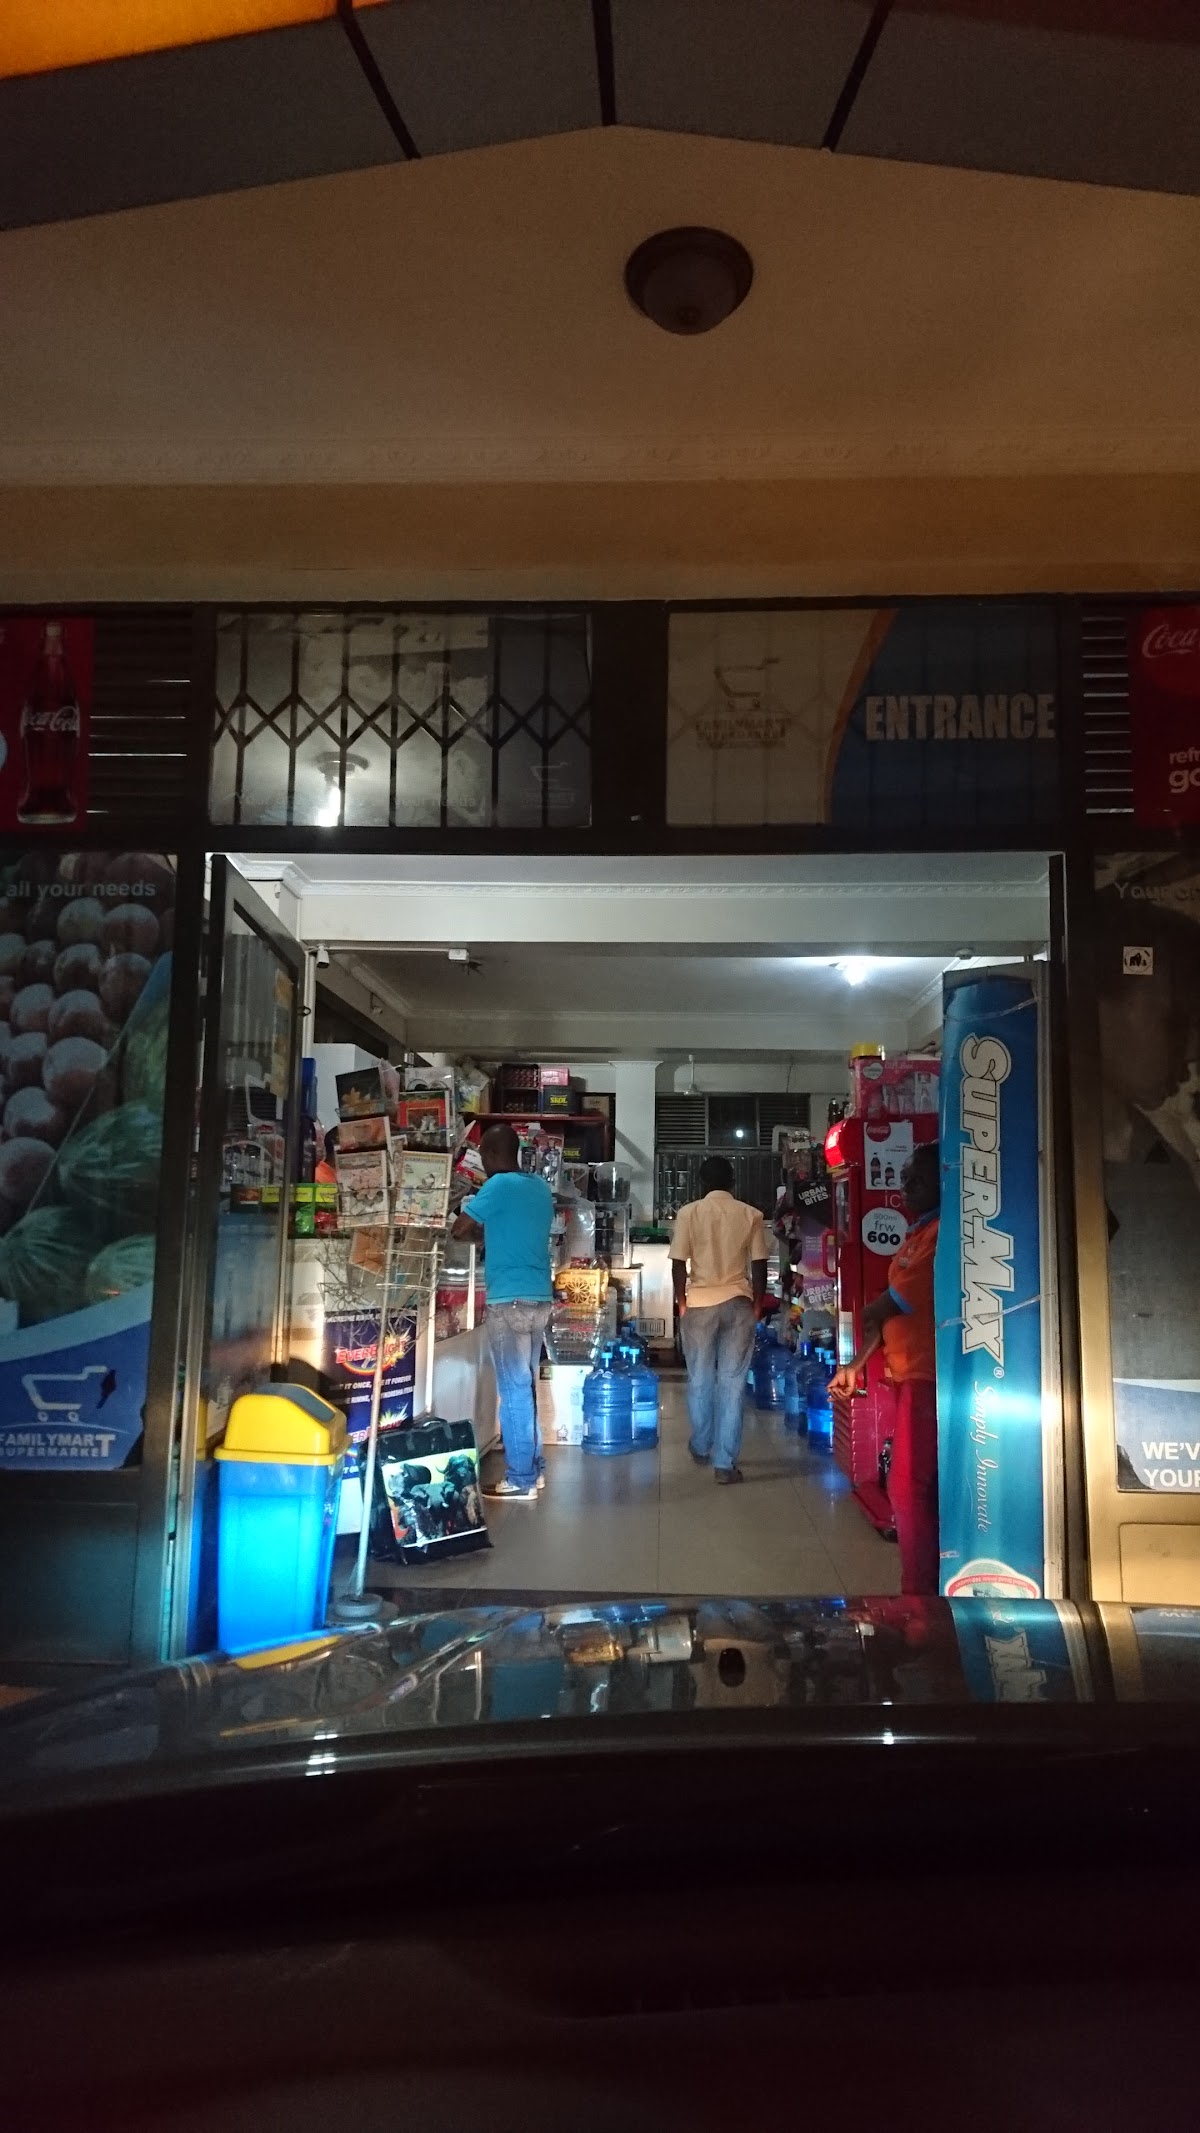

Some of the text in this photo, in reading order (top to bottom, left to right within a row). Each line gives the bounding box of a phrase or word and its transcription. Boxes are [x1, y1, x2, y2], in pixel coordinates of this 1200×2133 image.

[865, 693, 1056, 740] ENTRANCE
[6, 880, 157, 903] all your needs
[798, 1185, 827, 1200] URBAN
[804, 1192, 829, 1206] BITES
[874, 1221, 896, 1232] frw
[867, 1230, 901, 1246] 600
[808, 1291, 833, 1304] BITES
[976, 1448, 999, 1534] Innovate
